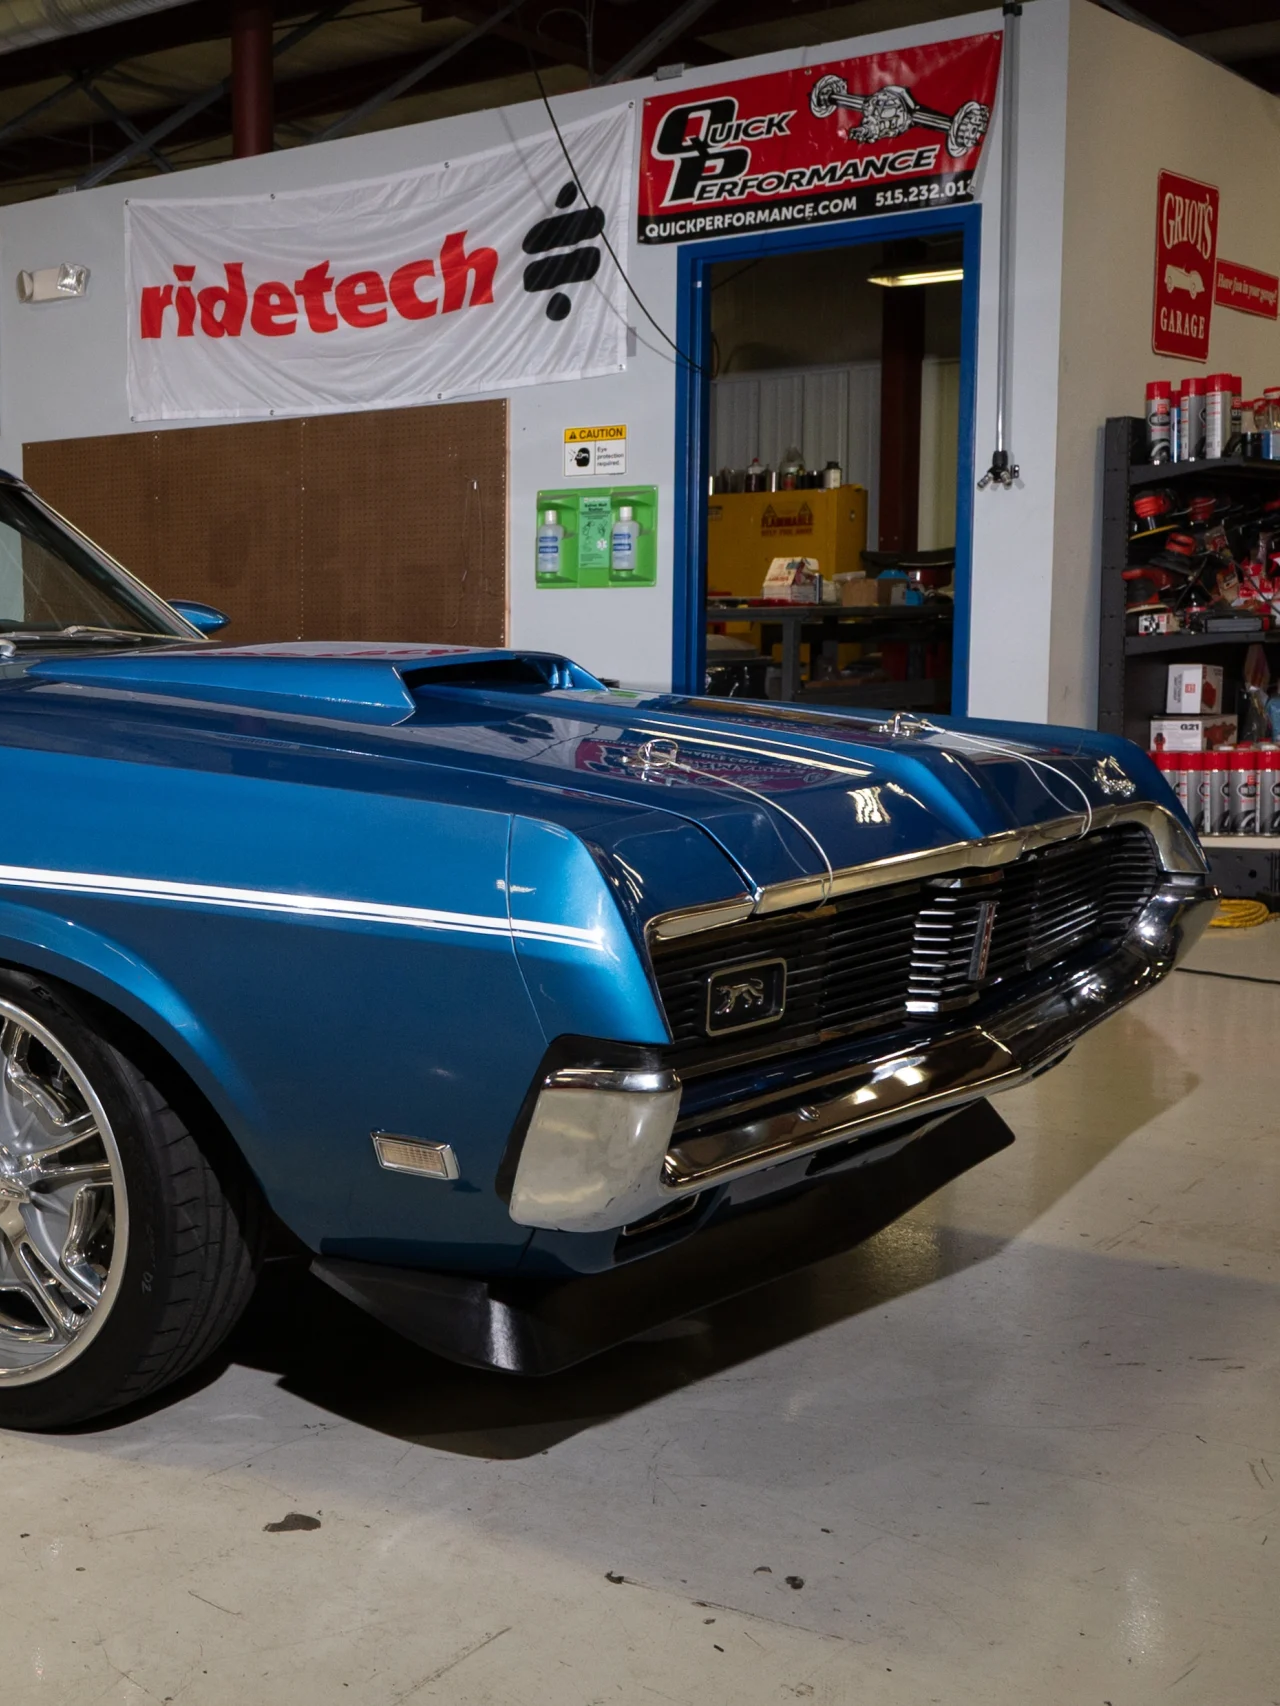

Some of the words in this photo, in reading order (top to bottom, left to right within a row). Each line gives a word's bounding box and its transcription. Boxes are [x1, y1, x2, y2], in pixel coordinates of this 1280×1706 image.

[652, 96, 797, 160] QUICK
[659, 145, 941, 208] PERFORMANCE
[644, 196, 858, 238] QUICKPERFORMANCE.COM
[1162, 192, 1214, 260] GRIOT'S
[140, 230, 500, 339] ridetech
[1160, 306, 1206, 340] GARAGE
[579, 427, 623, 440] CAUTION
